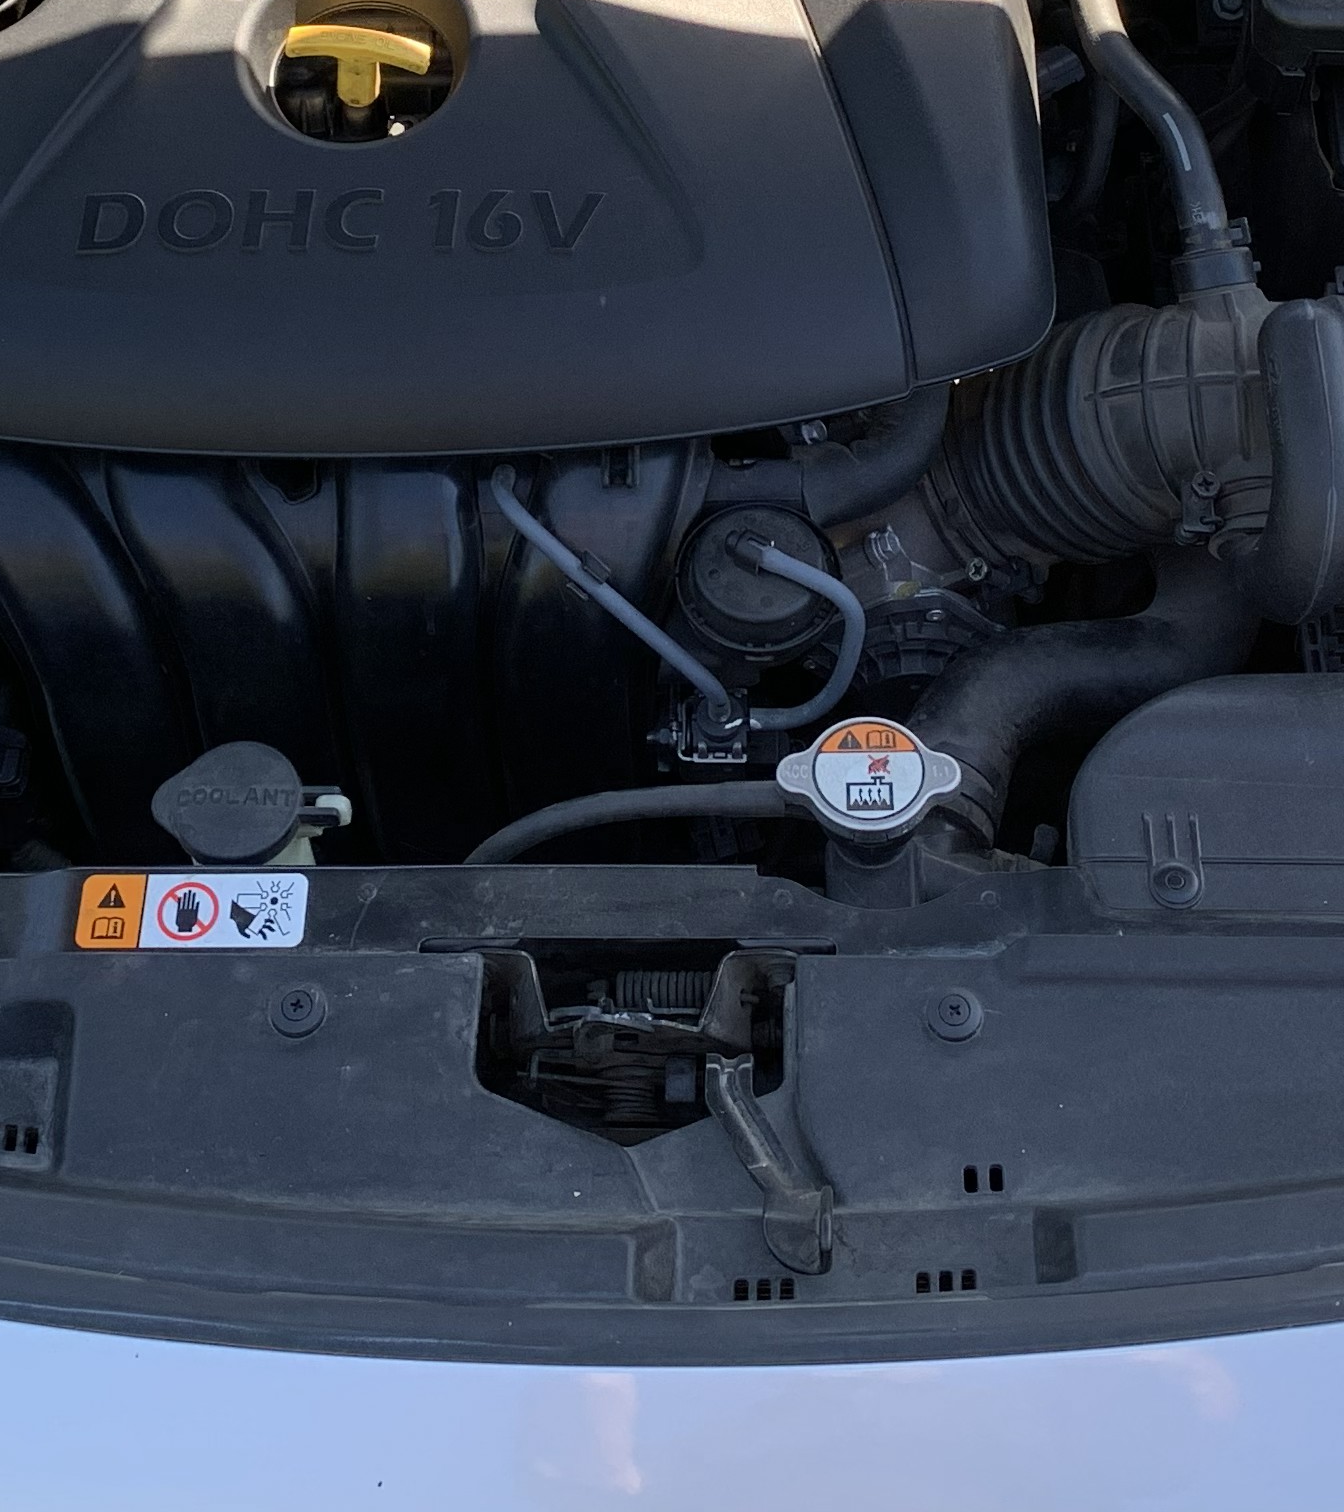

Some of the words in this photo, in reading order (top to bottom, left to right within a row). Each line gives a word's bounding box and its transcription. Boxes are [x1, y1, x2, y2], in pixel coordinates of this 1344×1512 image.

[74, 187, 386, 255] DOHC
[426, 187, 607, 255] 16V
[176, 786, 297, 808] COOLANT
